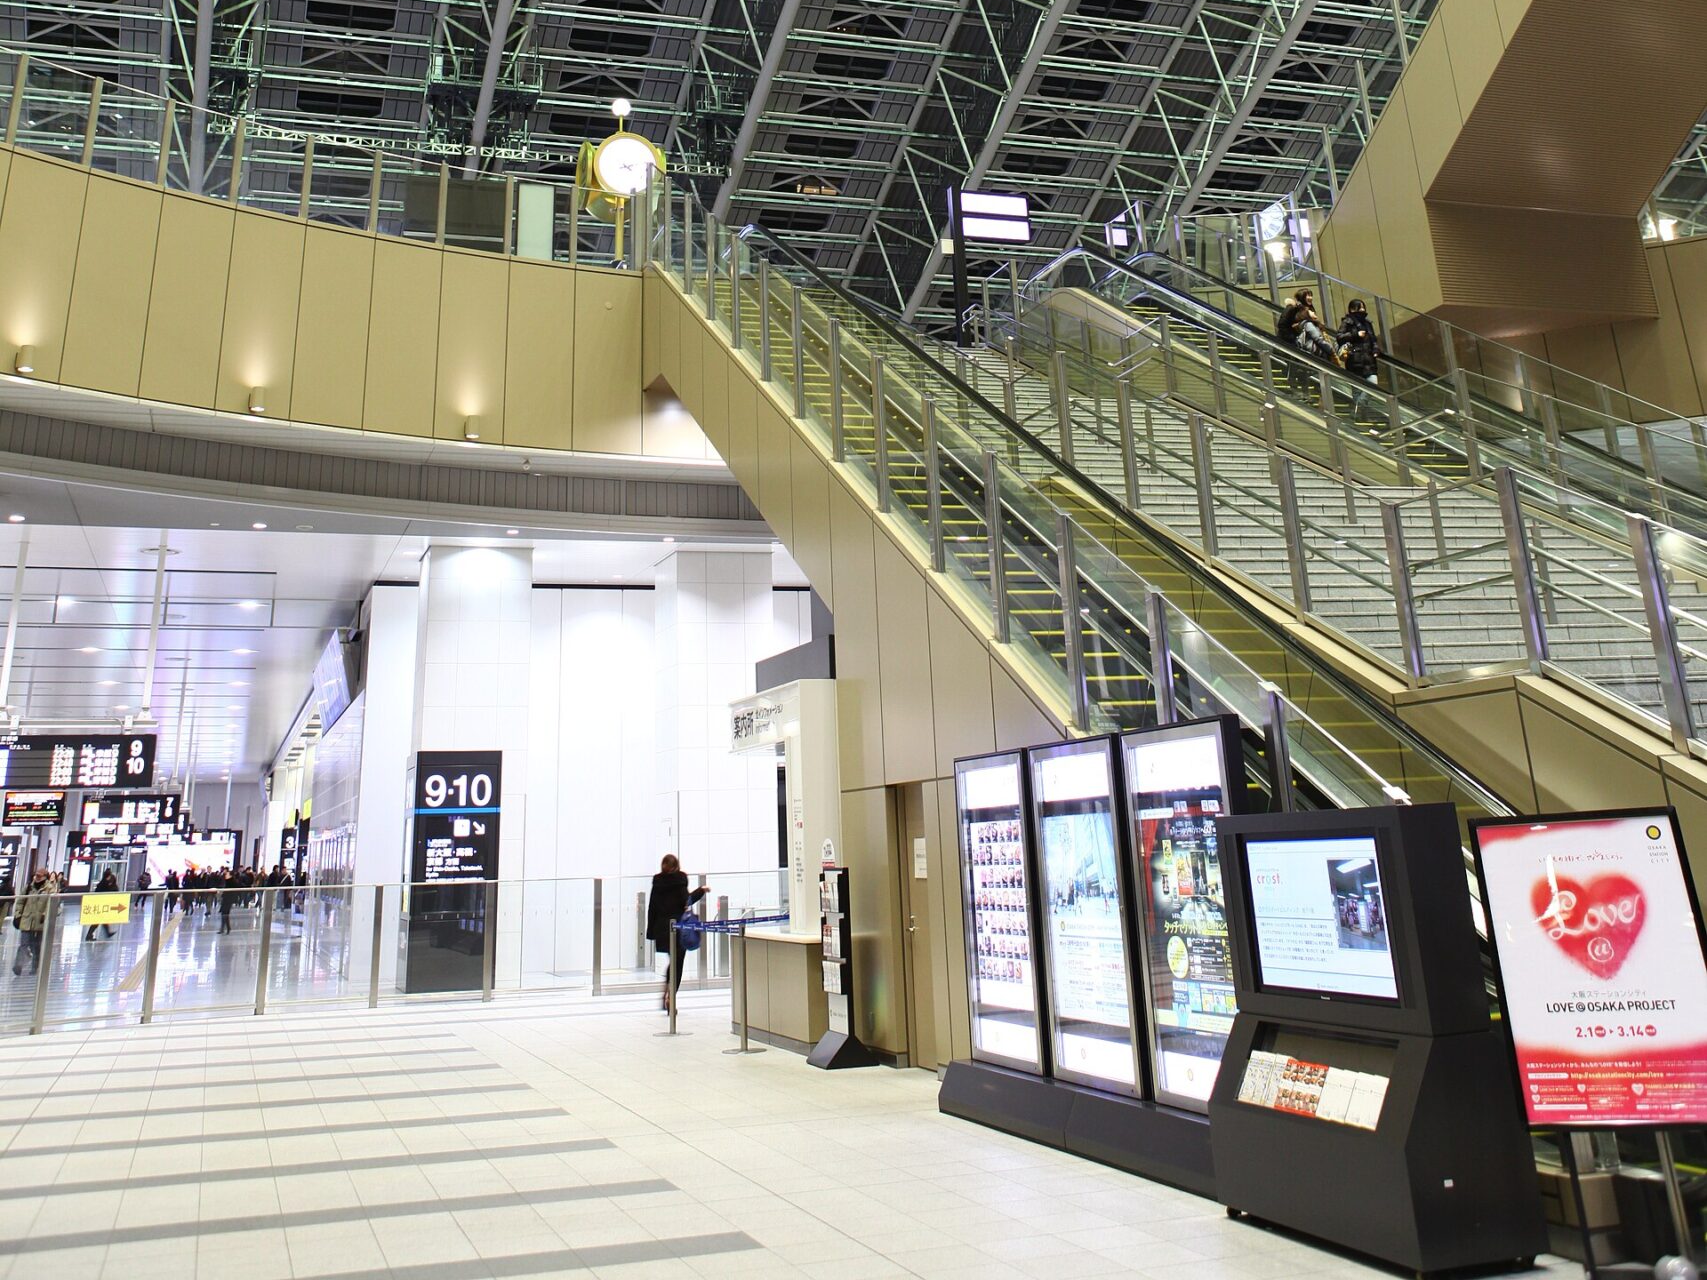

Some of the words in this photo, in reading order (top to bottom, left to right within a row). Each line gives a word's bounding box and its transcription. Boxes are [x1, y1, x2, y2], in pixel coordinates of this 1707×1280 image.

[733, 711, 754, 739] 案内所
[130, 740, 143, 757] 9
[126, 757, 145, 774] 10
[166, 797, 174, 807] 7
[83, 904, 109, 915] 改札口
[1549, 890, 1640, 940] Love
[1571, 990, 1646, 999] 大阪ステーションシティ
[1628, 1000, 1676, 1011] PROJECT
[1576, 1026, 1593, 1037] 2.1
[1617, 1025, 1644, 1037] 3.14
